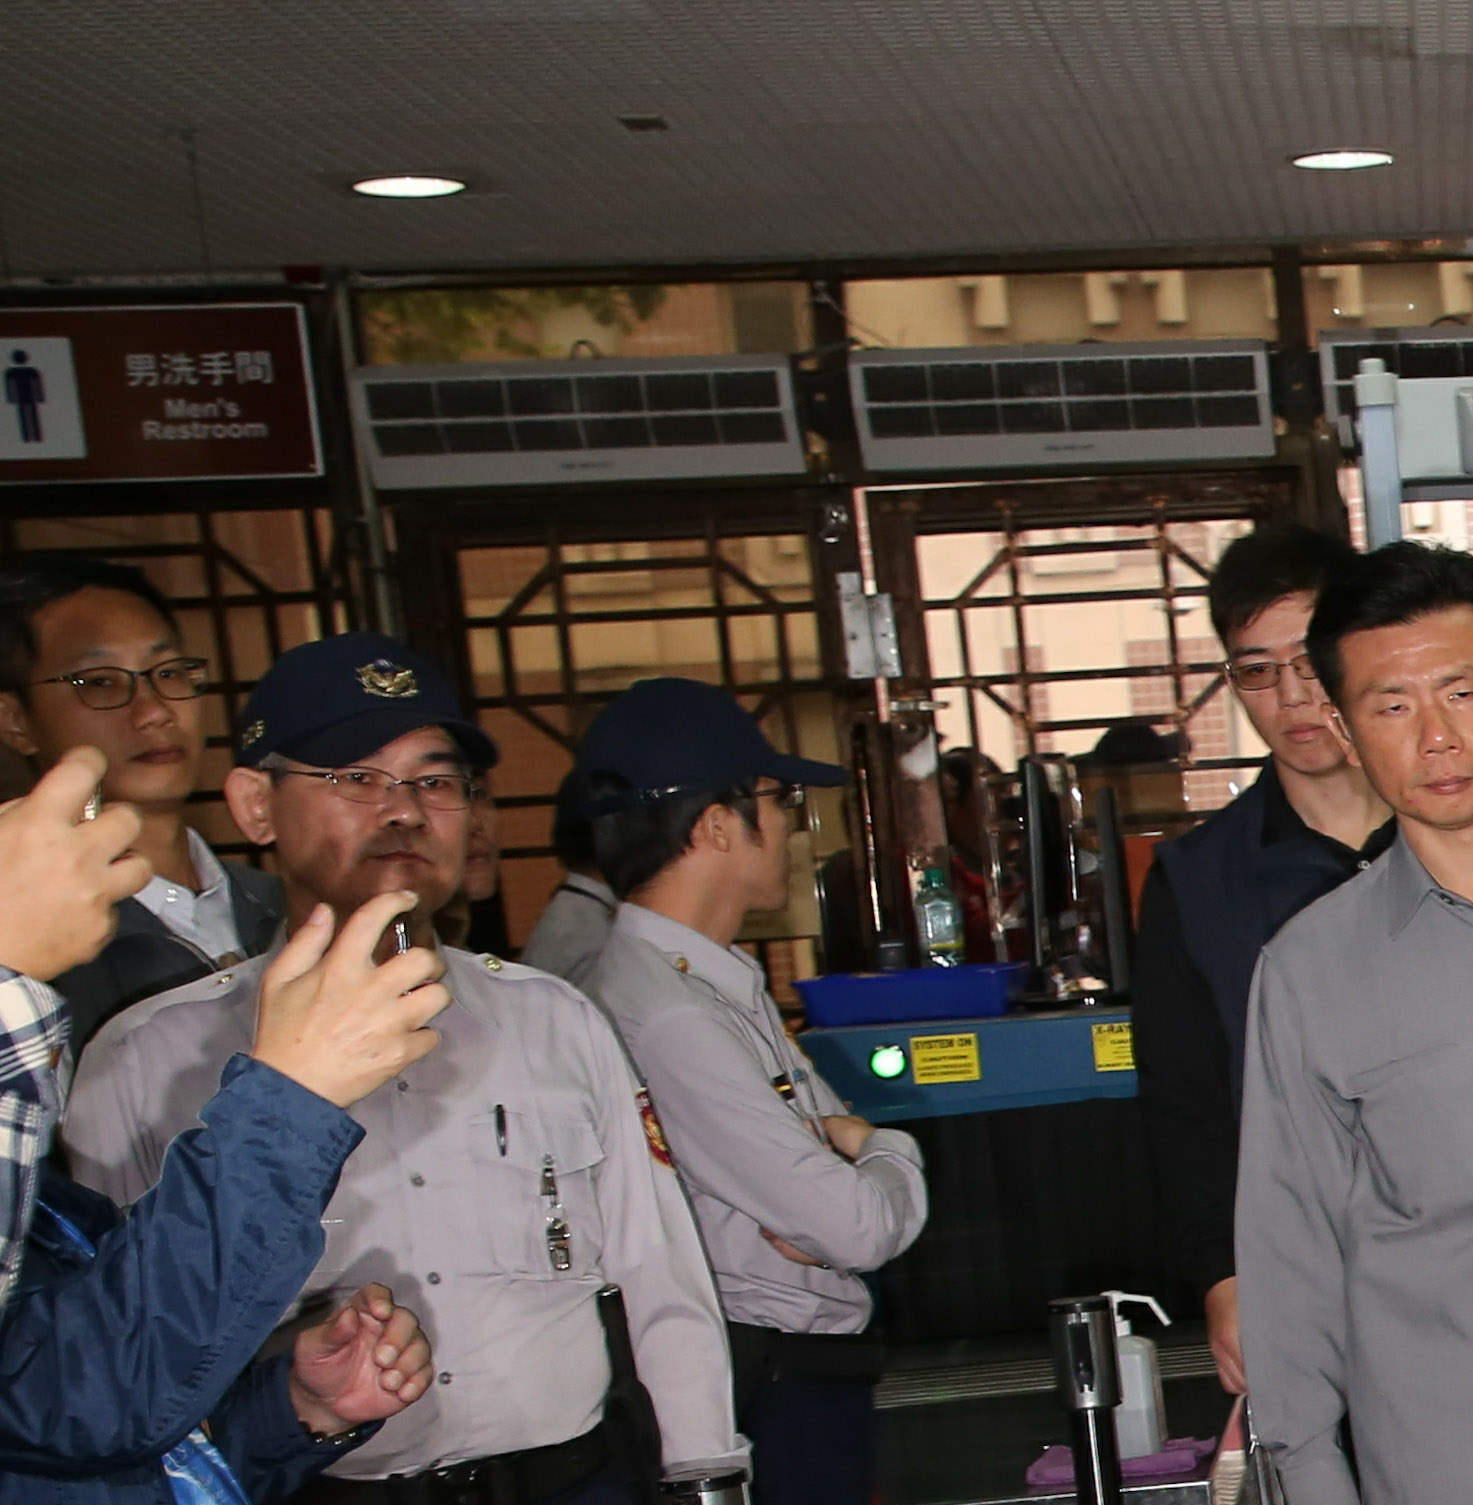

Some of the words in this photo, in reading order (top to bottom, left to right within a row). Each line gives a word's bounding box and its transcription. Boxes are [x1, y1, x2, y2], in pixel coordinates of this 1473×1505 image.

[125, 351, 275, 387] 男洗手間
[164, 398, 241, 418] Men's
[142, 420, 270, 440] Restroom
